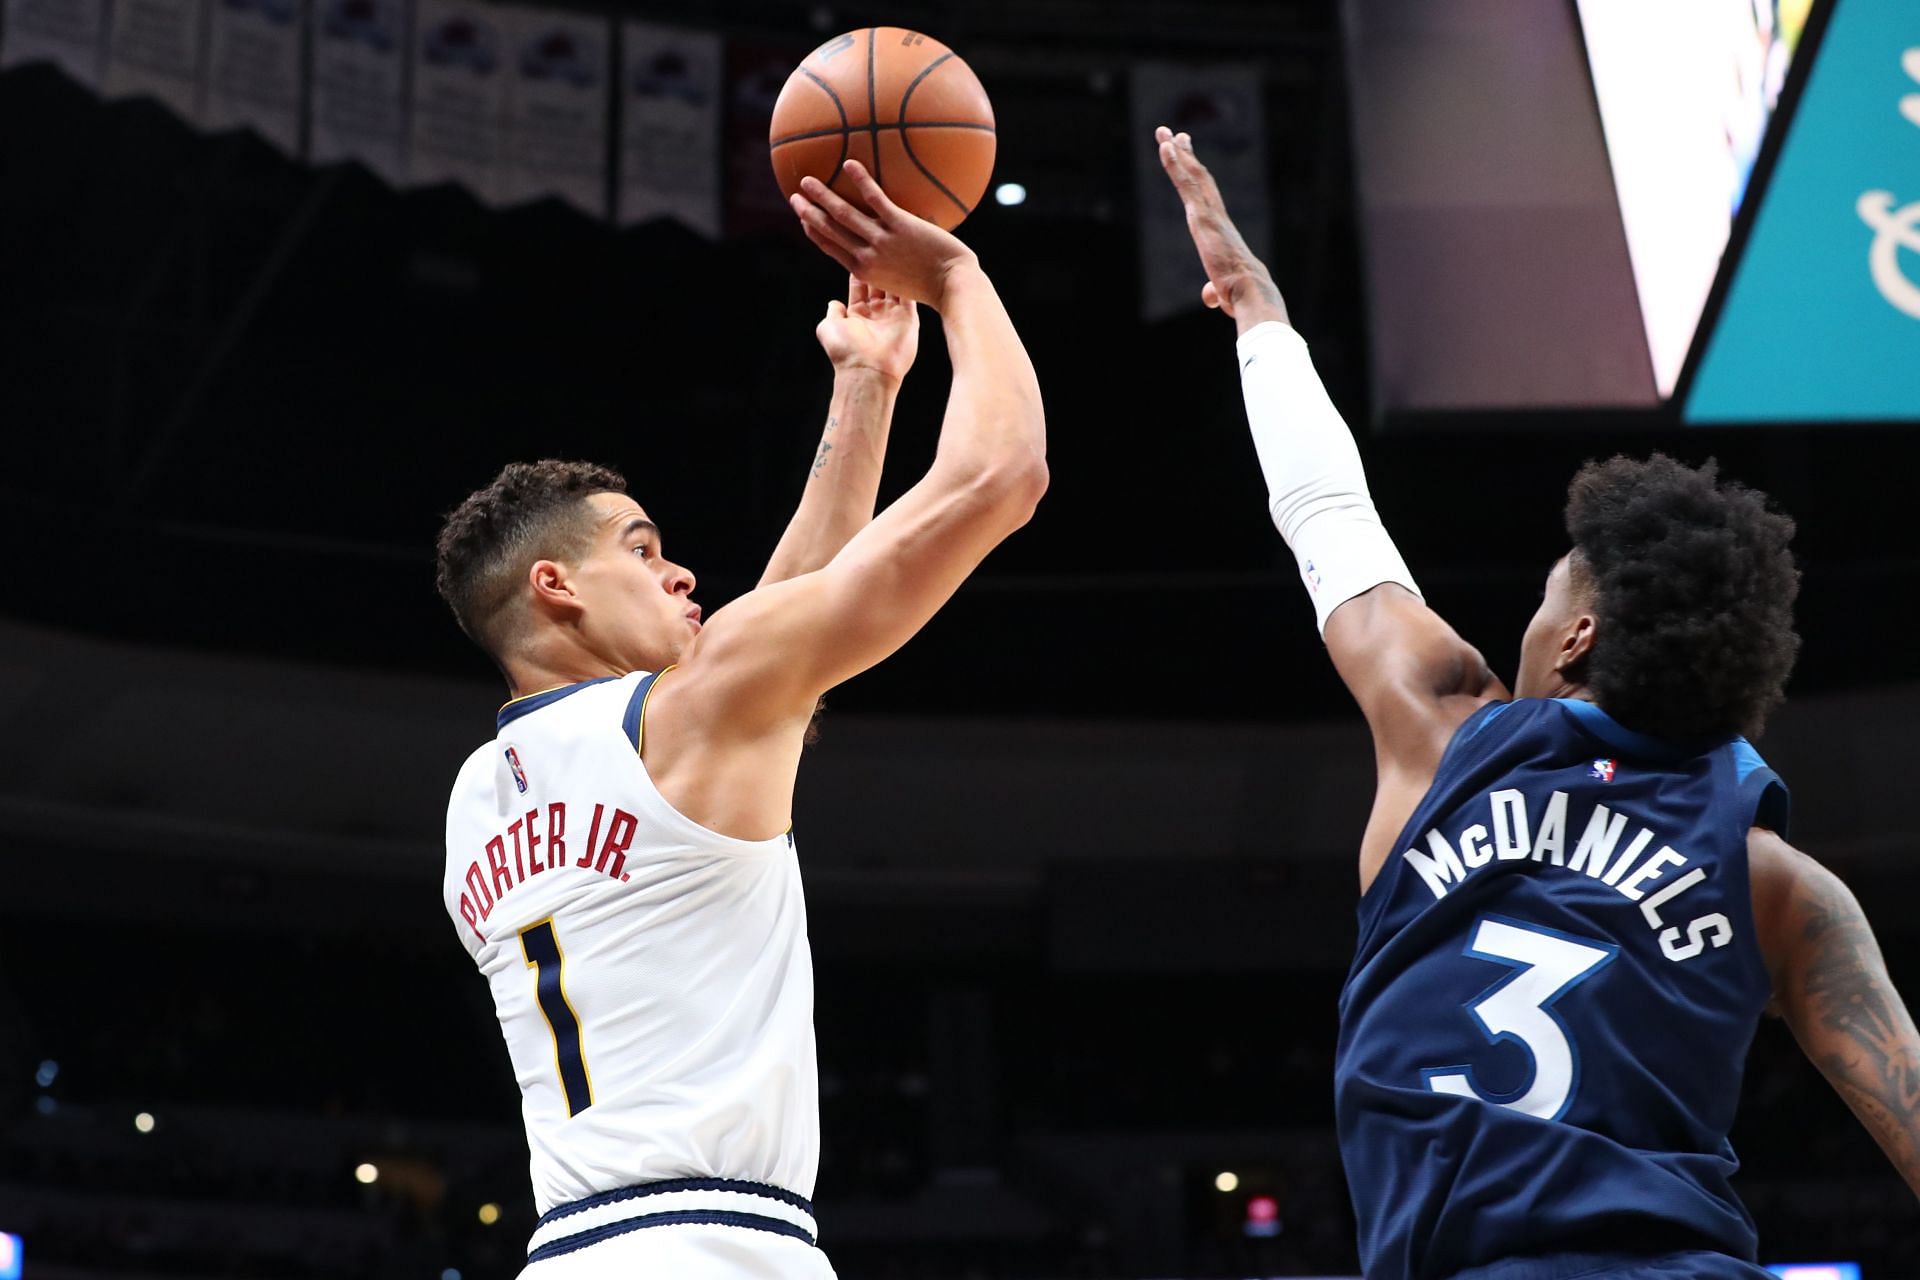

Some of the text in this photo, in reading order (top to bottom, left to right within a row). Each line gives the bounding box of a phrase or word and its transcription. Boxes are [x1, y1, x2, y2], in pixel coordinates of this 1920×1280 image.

[460, 802, 639, 945] PORTER JR.
[1403, 788, 1734, 962] McDANIELS
[517, 915, 594, 1120] 1
[1421, 916, 1621, 1122] 3
